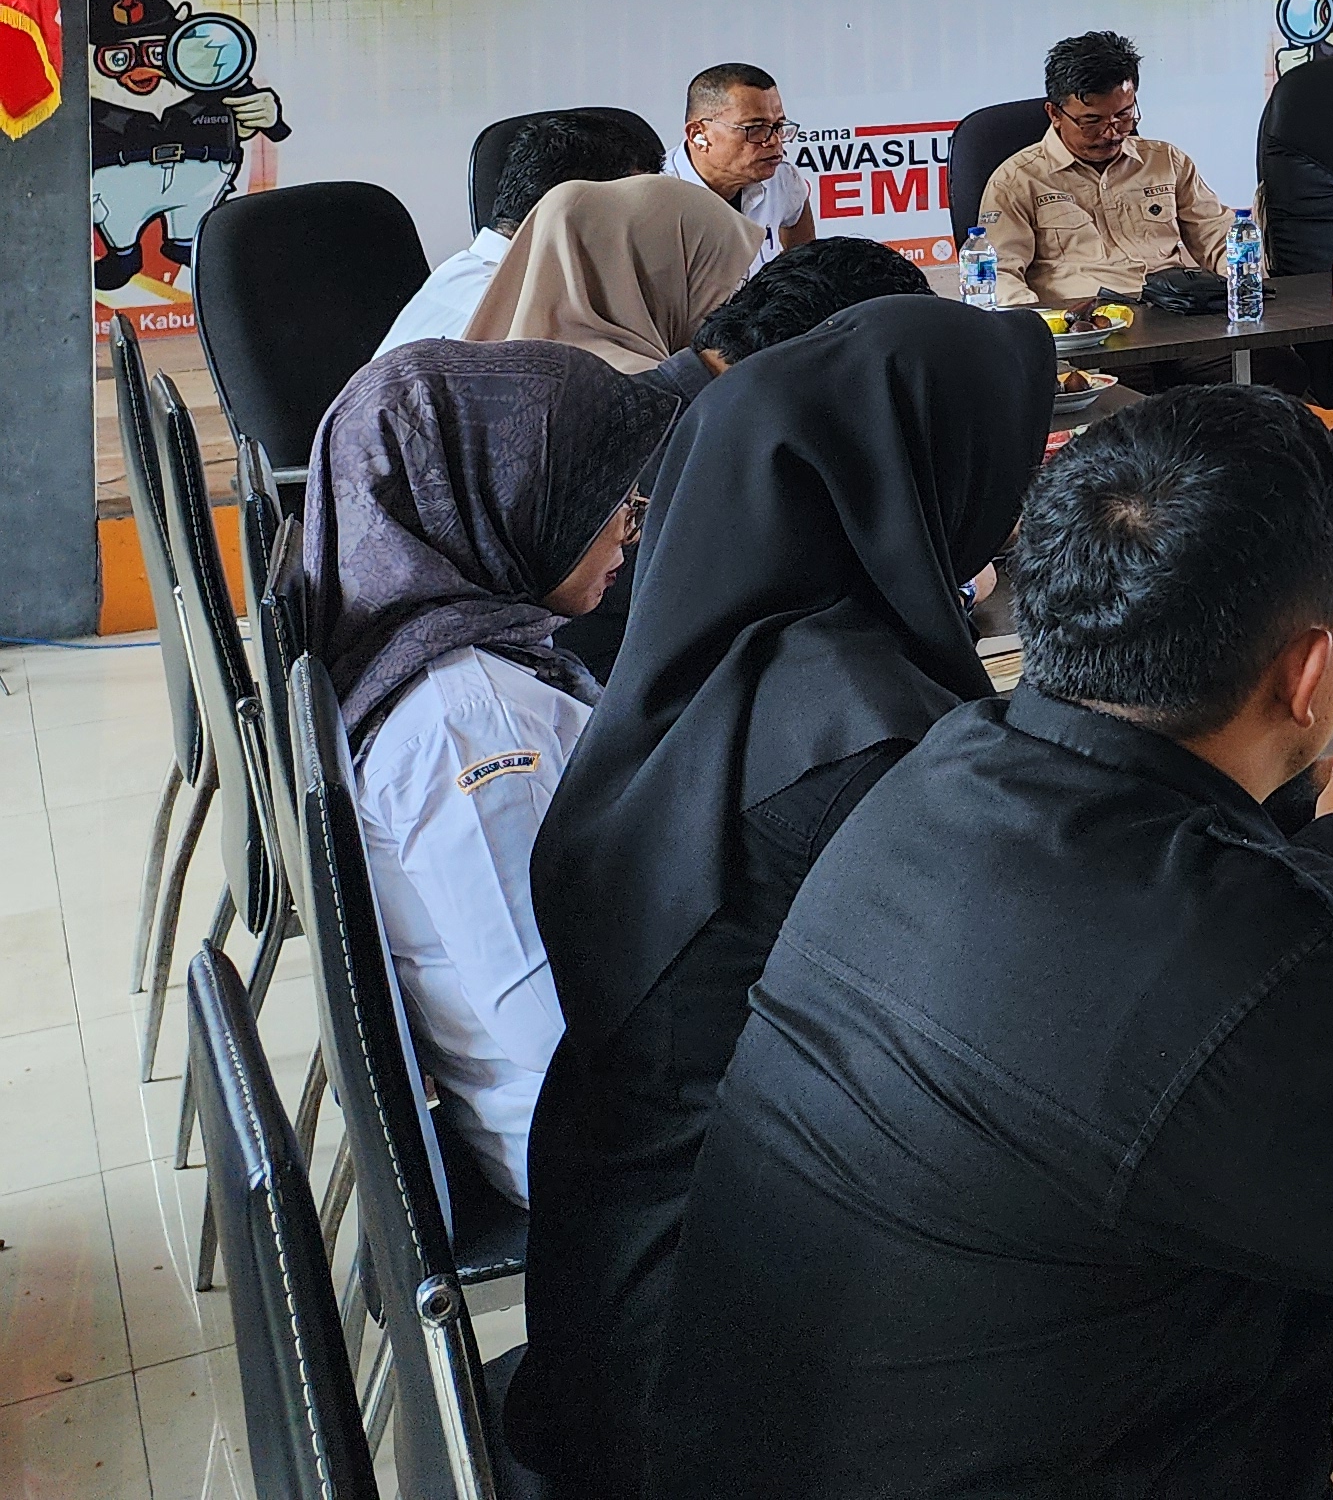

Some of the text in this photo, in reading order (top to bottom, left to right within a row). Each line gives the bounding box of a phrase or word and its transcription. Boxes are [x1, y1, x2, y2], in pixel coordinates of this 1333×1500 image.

[797, 128, 851, 143] sama
[784, 137, 950, 172] AWASLU
[805, 166, 950, 219] EMI
[140, 312, 196, 331] Kabu
